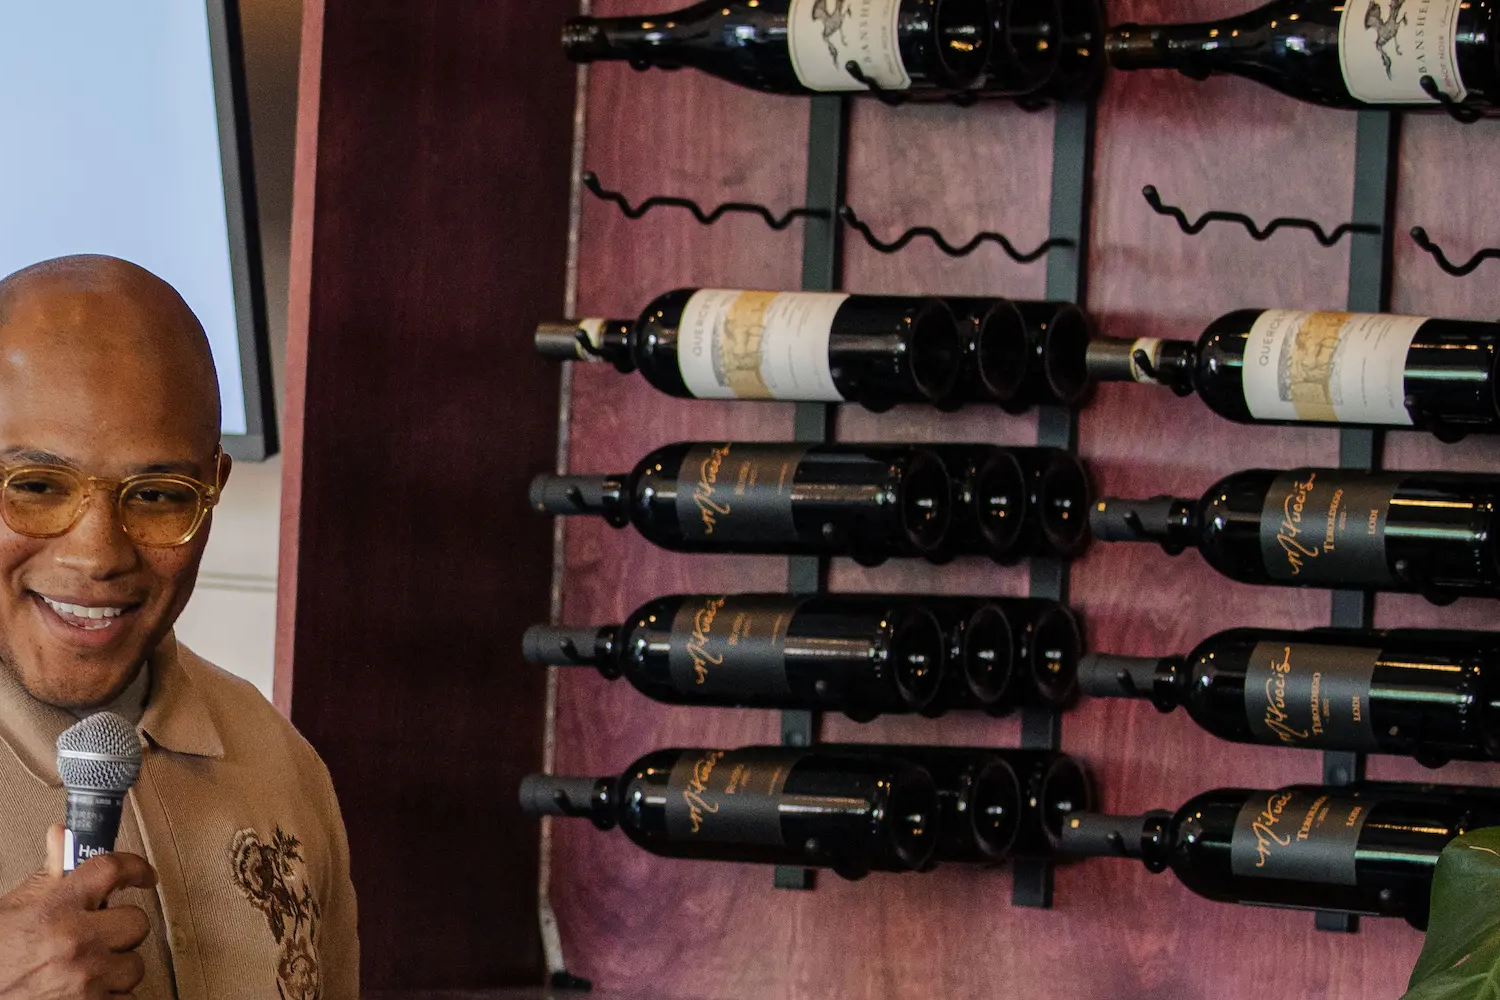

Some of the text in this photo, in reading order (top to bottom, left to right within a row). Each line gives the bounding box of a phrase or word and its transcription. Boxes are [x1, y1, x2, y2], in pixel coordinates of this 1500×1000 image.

[1415, 0, 1431, 73] BANSHE
[1367, 509, 1379, 535] LODI
[1351, 696, 1361, 721] LODI
